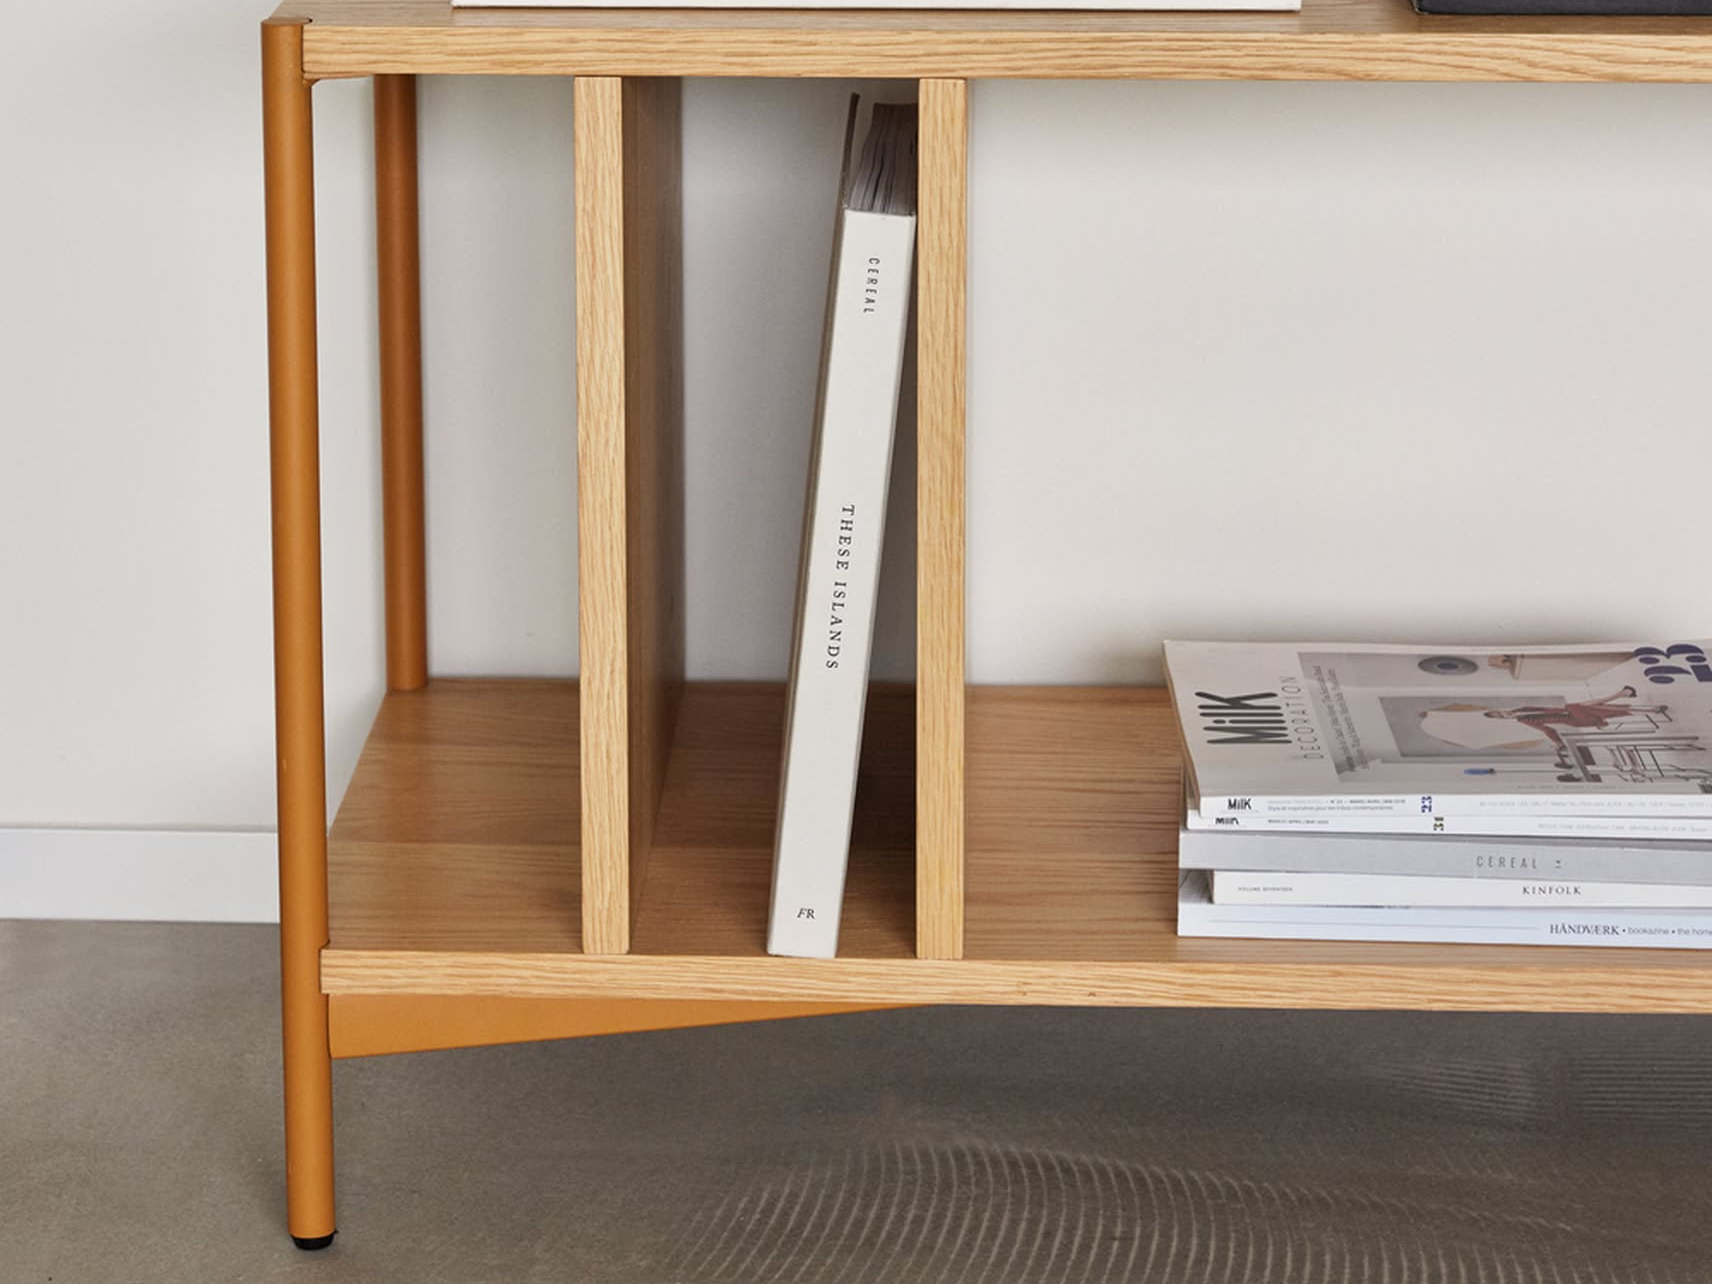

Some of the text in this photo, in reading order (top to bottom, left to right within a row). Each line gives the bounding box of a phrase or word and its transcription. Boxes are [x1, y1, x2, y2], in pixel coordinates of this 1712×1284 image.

[863, 257, 881, 314] CEREAL
[826, 504, 856, 669] THESE ISLANDS
[1194, 691, 1293, 745] MilK
[1281, 676, 1325, 759] DECORATION
[1227, 798, 1252, 811] MilK
[1421, 796, 1433, 813] 23
[1476, 855, 1537, 869] CEREAL
[1522, 885, 1582, 895] KINFOLK
[797, 907, 815, 920] FR
[1550, 922, 1620, 935] HÅNDVÆRK
